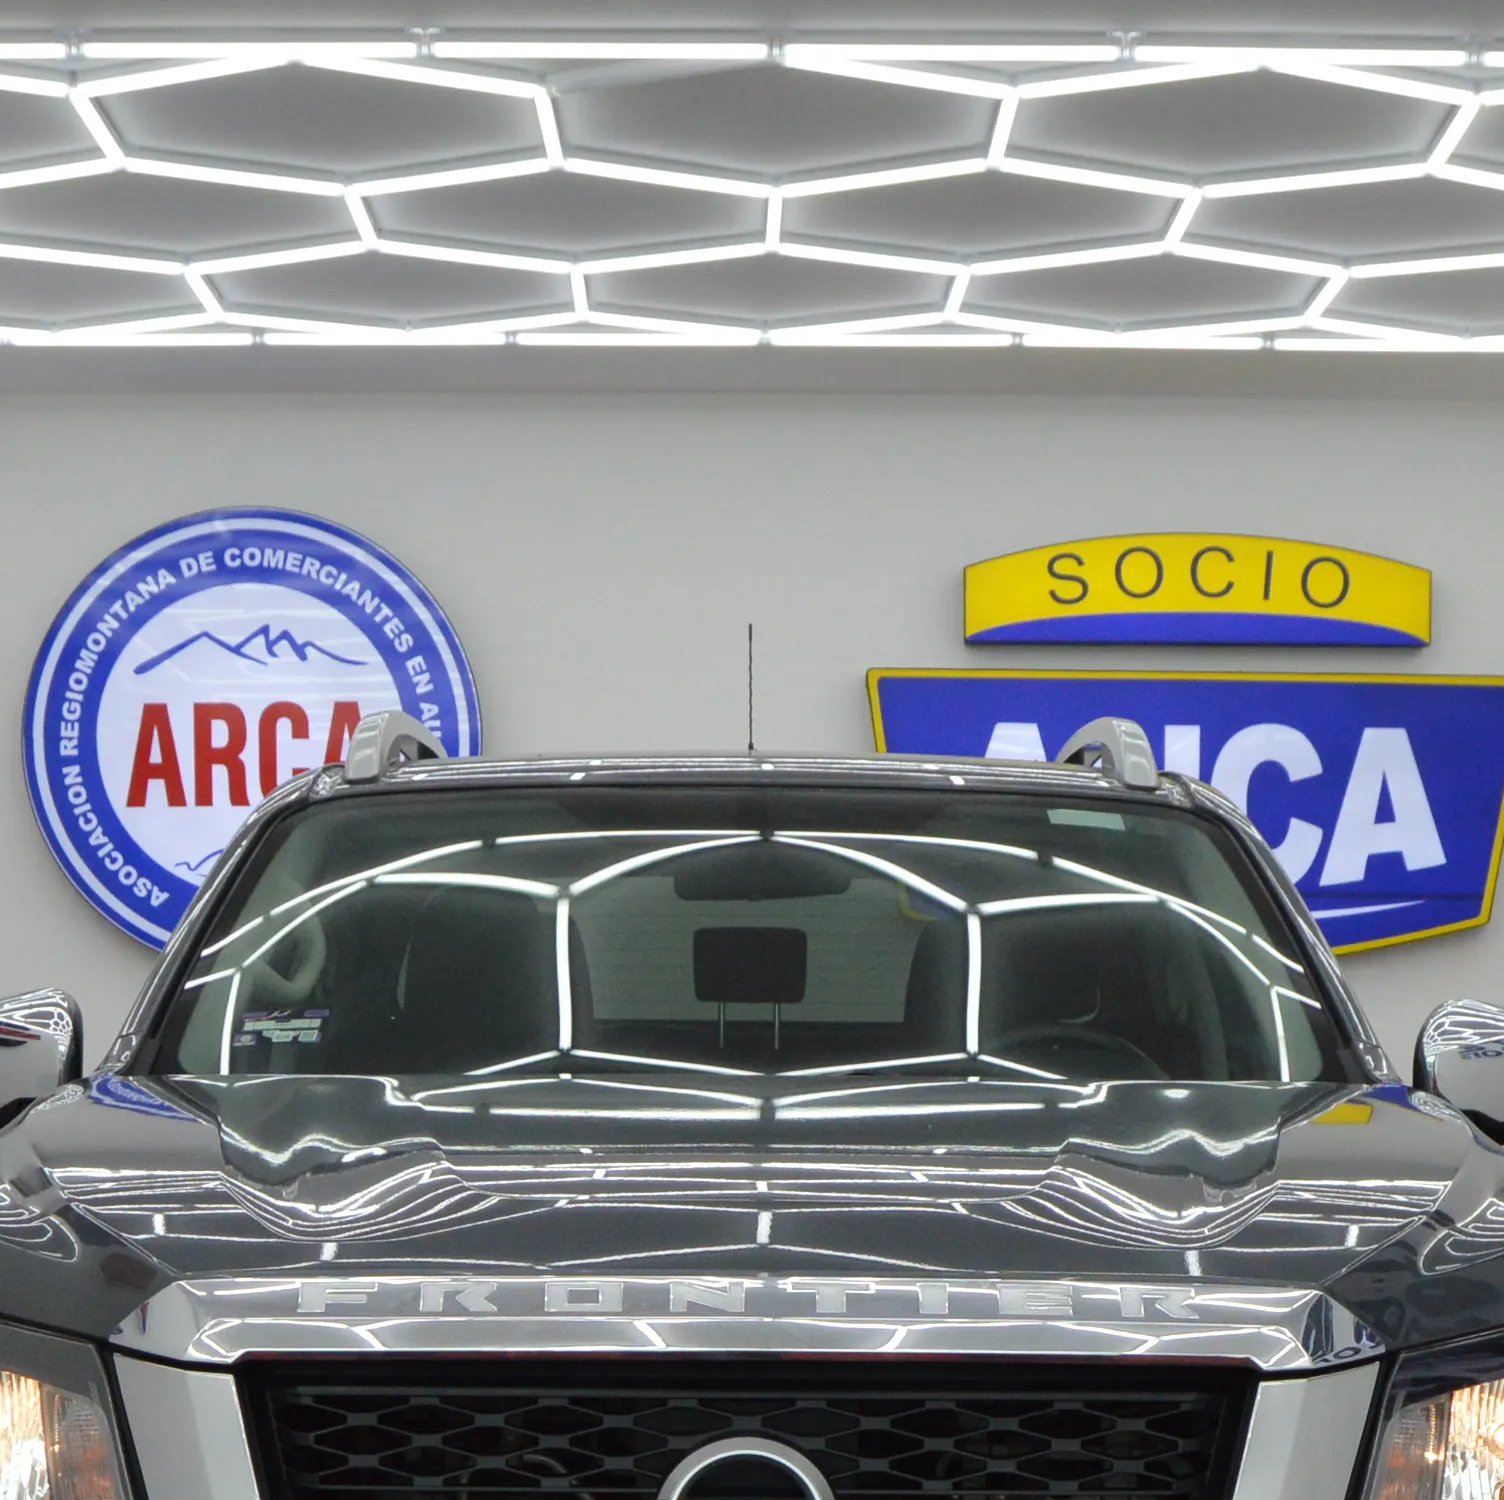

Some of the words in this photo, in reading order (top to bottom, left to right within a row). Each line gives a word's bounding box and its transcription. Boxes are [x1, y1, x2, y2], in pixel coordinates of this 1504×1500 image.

[179, 551, 217, 578] DE
[223, 547, 414, 653] COMERCIANTES
[1046, 545, 1351, 609] SOCIO
[59, 567, 177, 756] REGIOMONTANA
[404, 655, 434, 695] EN
[62, 764, 170, 907] ASOCIACION
[983, 720, 1447, 887] CA
[295, 1279, 1200, 1319] FRONTIER
